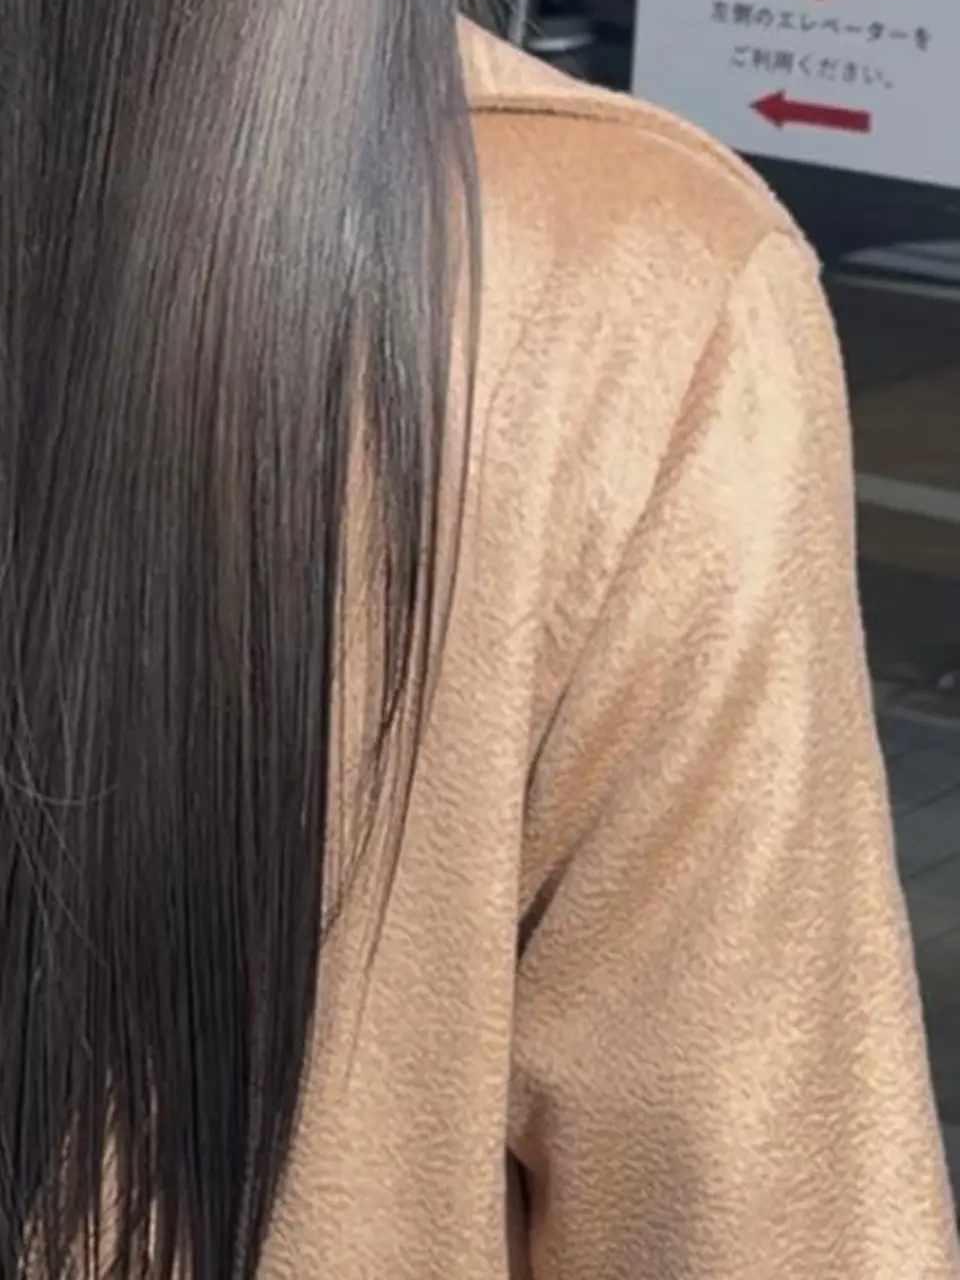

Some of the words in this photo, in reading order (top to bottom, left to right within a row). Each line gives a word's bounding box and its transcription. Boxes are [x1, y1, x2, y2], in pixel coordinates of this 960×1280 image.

[711, 0, 933, 52] 左側のエレベーターを
[730, 45, 894, 90] ご利用ください。
